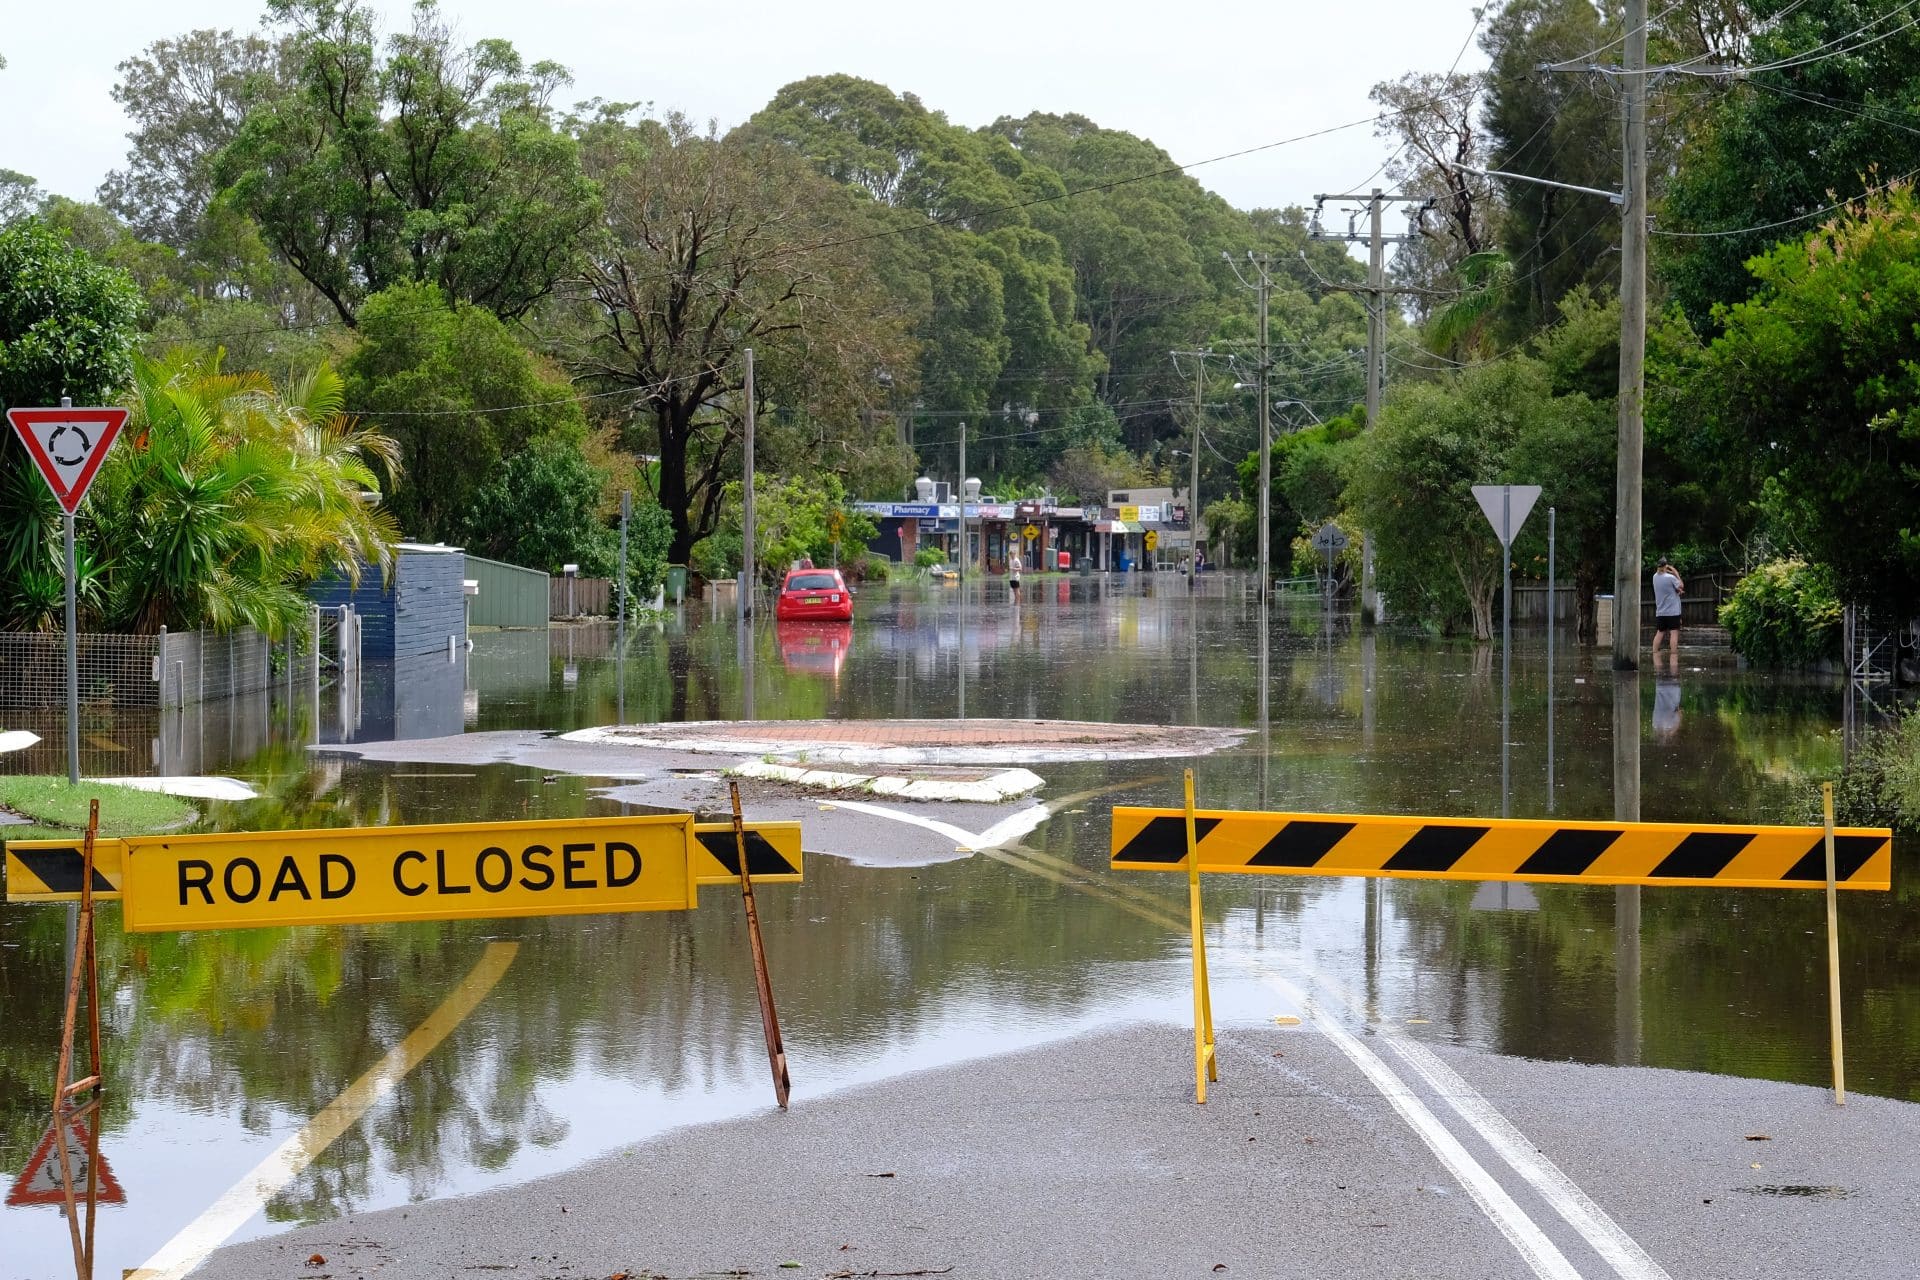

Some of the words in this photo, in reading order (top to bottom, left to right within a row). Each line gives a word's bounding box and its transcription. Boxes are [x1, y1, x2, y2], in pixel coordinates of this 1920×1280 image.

[894, 505, 930, 515] Pharmacy
[177, 854, 356, 906] ROAD
[392, 841, 643, 897] CLOSED
